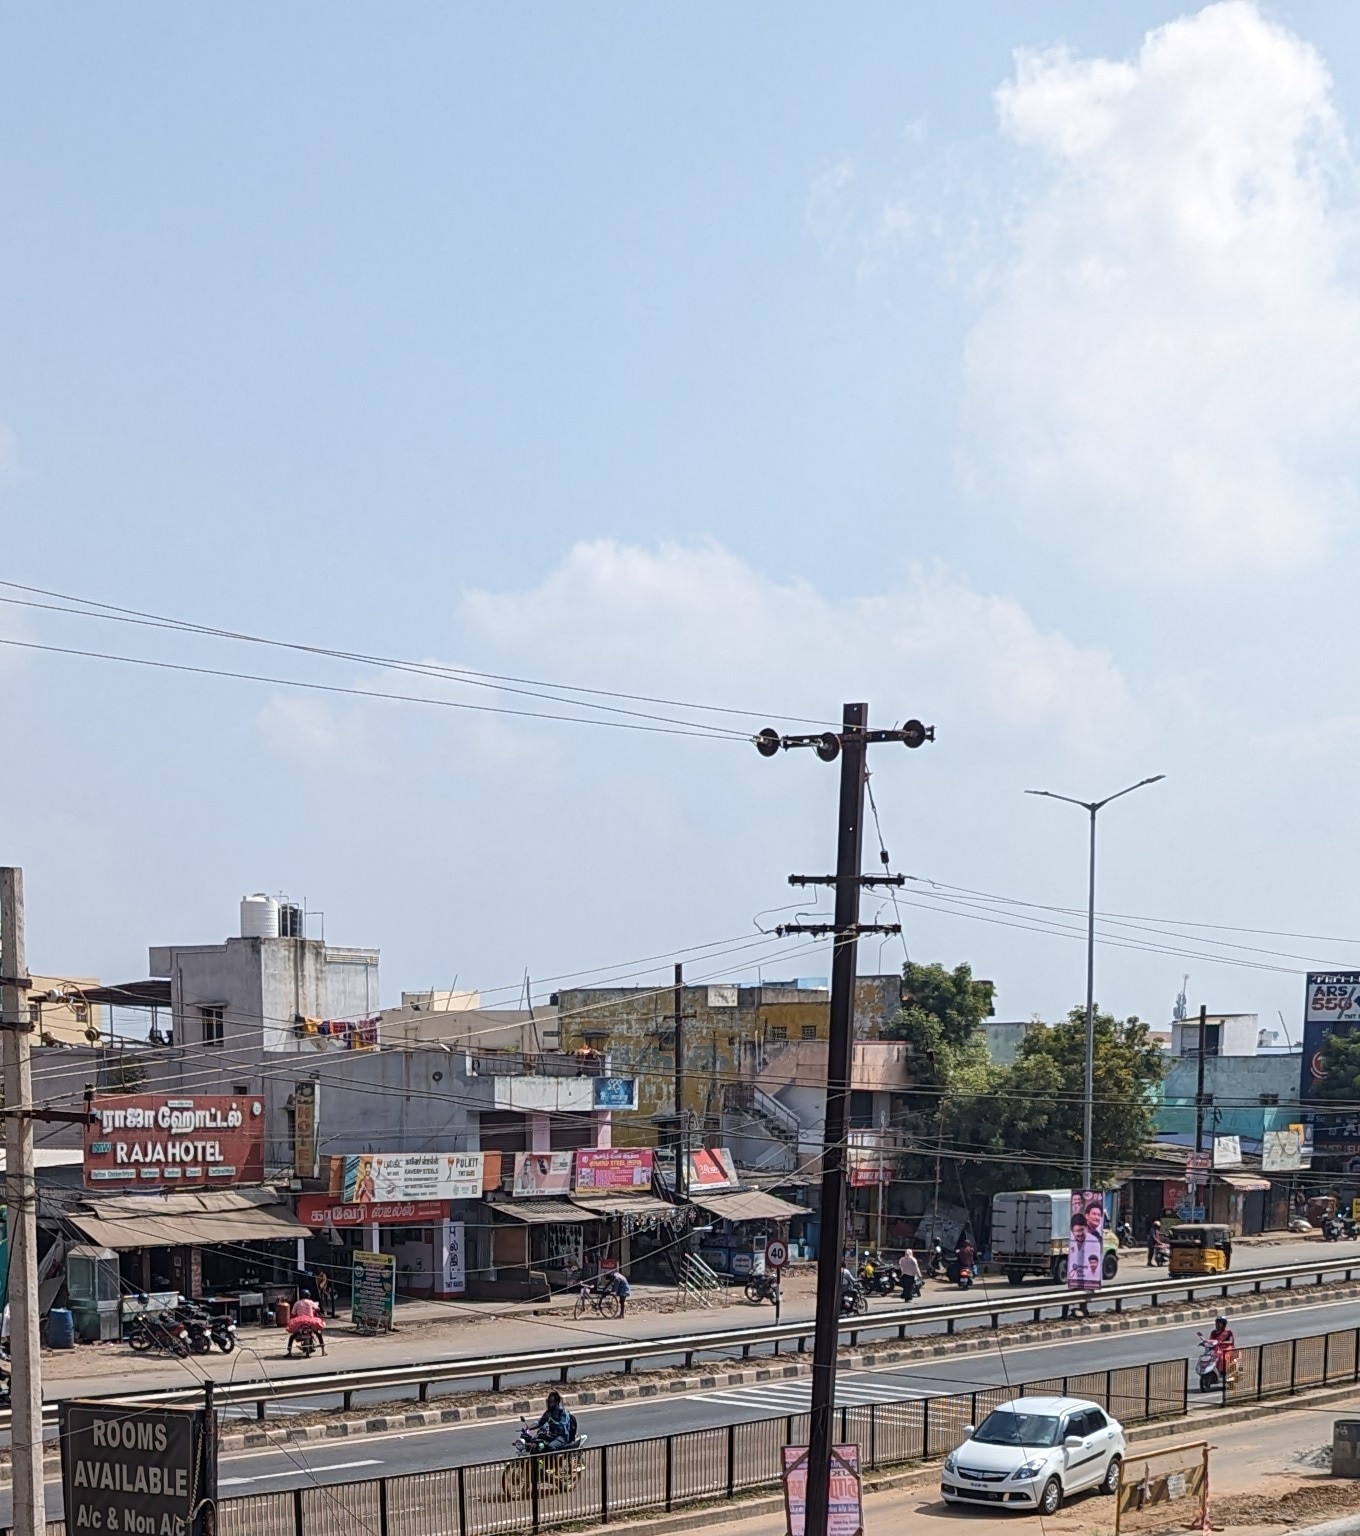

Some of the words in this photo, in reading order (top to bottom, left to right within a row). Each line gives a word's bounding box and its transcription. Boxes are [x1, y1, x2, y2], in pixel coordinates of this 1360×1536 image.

[1314, 986, 1348, 997] ARS
[102, 1106, 155, 1134] ராஜா
[157, 1102, 242, 1134] ஹோட்டல்
[116, 1141, 166, 1164] RAJA
[168, 1140, 224, 1163] HOTEL
[770, 1247, 784, 1259] 40
[93, 1418, 168, 1452] ROOMS
[74, 1460, 188, 1498] AVAILABLE
[77, 1504, 102, 1529] A/c
[107, 1506, 120, 1531] &
[124, 1508, 156, 1536] Non
